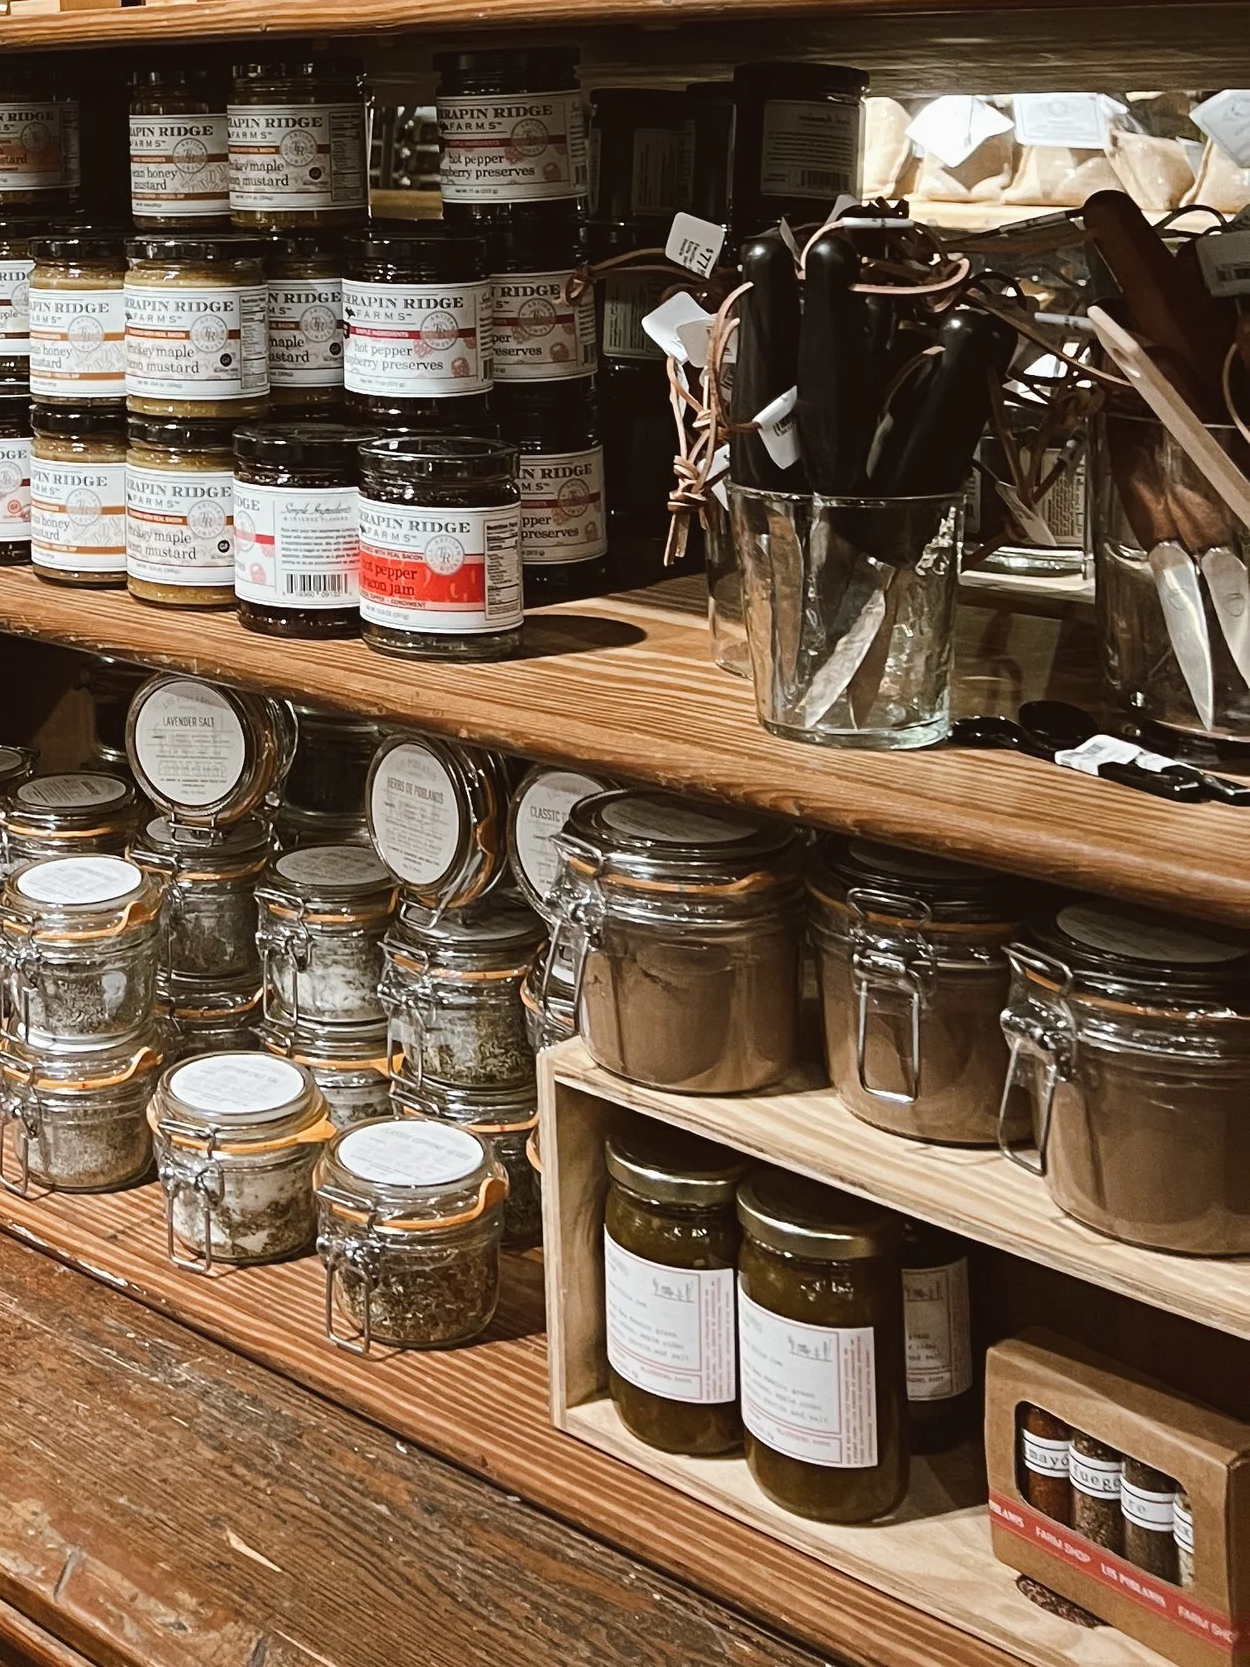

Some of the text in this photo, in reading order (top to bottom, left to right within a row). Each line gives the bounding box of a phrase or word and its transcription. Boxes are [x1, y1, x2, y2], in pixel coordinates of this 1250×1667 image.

[493, 105, 554, 118] RIDGE
[265, 116, 323, 128] RIDGE
[158, 125, 213, 136] RIDGE
[464, 153, 505, 167] pepper
[147, 167, 178, 181] honey
[250, 160, 284, 175] maple
[475, 167, 536, 180] preserves
[284, 291, 342, 304] RIDGE
[501, 284, 561, 298] RIDGE
[54, 302, 110, 314] RIDGE
[174, 300, 234, 313] RIDGE
[402, 296, 465, 310] RIDGE
[42, 346, 73, 359] honey
[156, 344, 194, 360] maple
[353, 340, 413, 358] hot pepper
[147, 361, 200, 373] mustard
[381, 358, 444, 372] preserves
[540, 463, 593, 480] RIDGE
[53, 474, 108, 487] RIDGE
[169, 486, 232, 499] RIDGE
[41, 516, 71, 530] honey
[408, 519, 471, 534] RIDGE
[154, 529, 192, 546] maple
[145, 546, 198, 561] mustard
[402, 552, 424, 562] BACON
[375, 563, 418, 581] pepper
[388, 579, 416, 598] jam
[163, 716, 215, 728] LAVENDER SALT
[529, 806, 561, 824] CLASSIC
